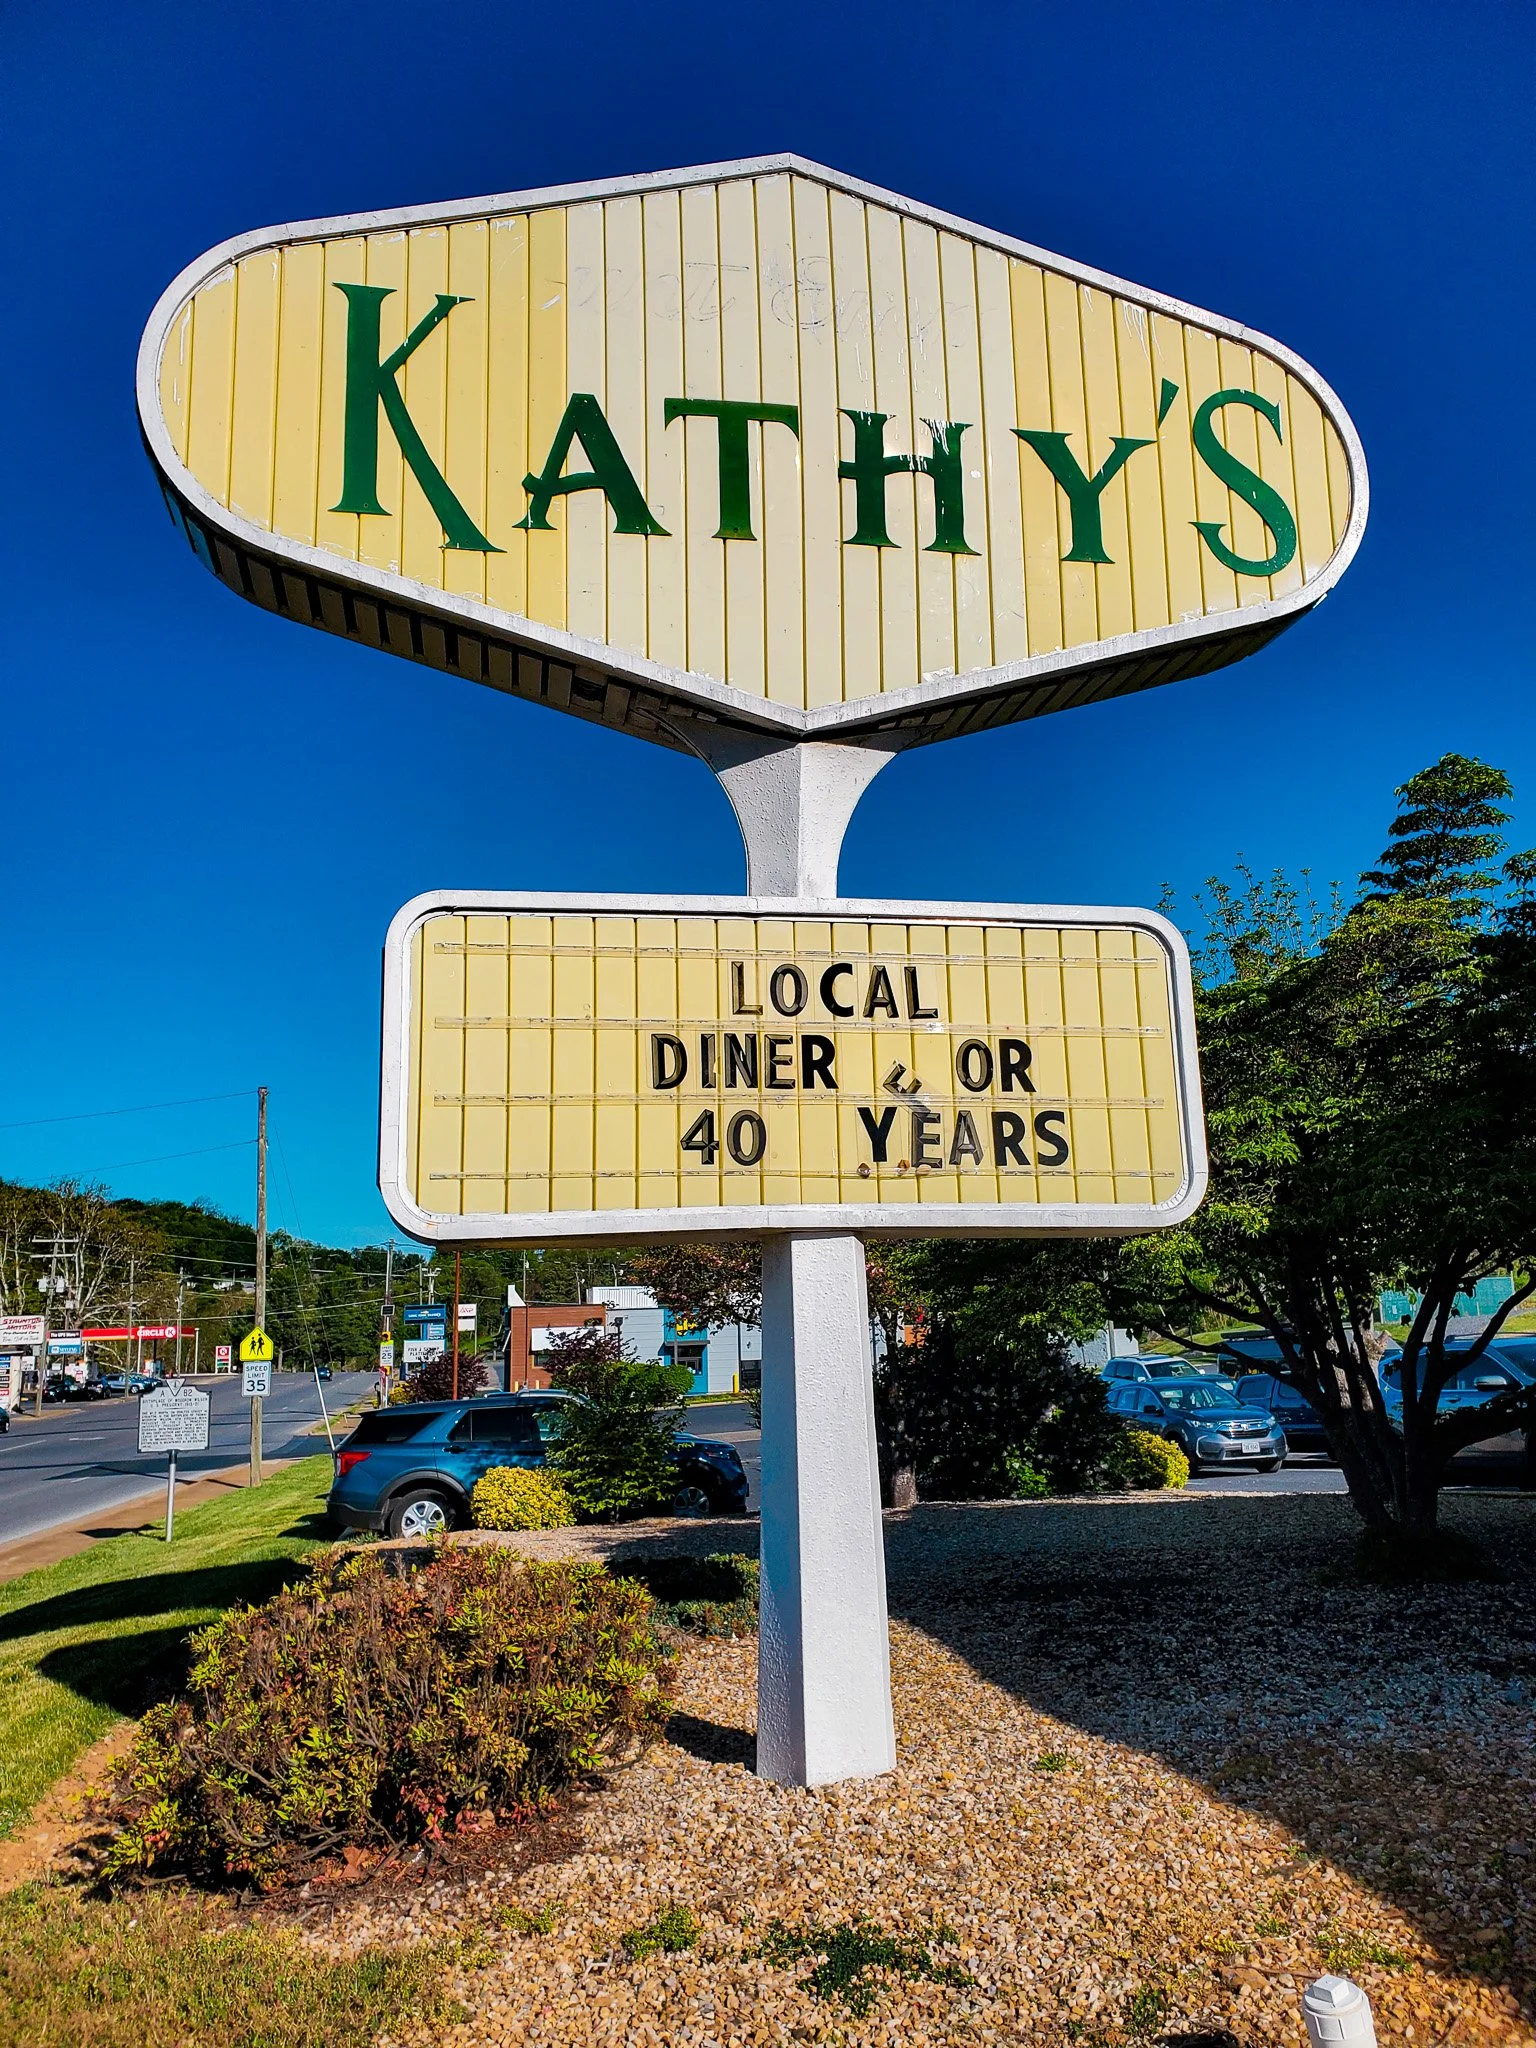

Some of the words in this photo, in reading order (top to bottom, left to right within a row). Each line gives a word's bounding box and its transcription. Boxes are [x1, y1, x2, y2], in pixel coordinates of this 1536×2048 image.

[329, 282, 1298, 577] KATHY'S
[731, 961, 938, 1020] LOCAL
[651, 1033, 838, 1090] DINER
[680, 1109, 766, 1166] 40
[857, 1106, 1069, 1168] YEARS
[137, 1328, 164, 1337] CIRCLE
[246, 1380, 266, 1391] 35
